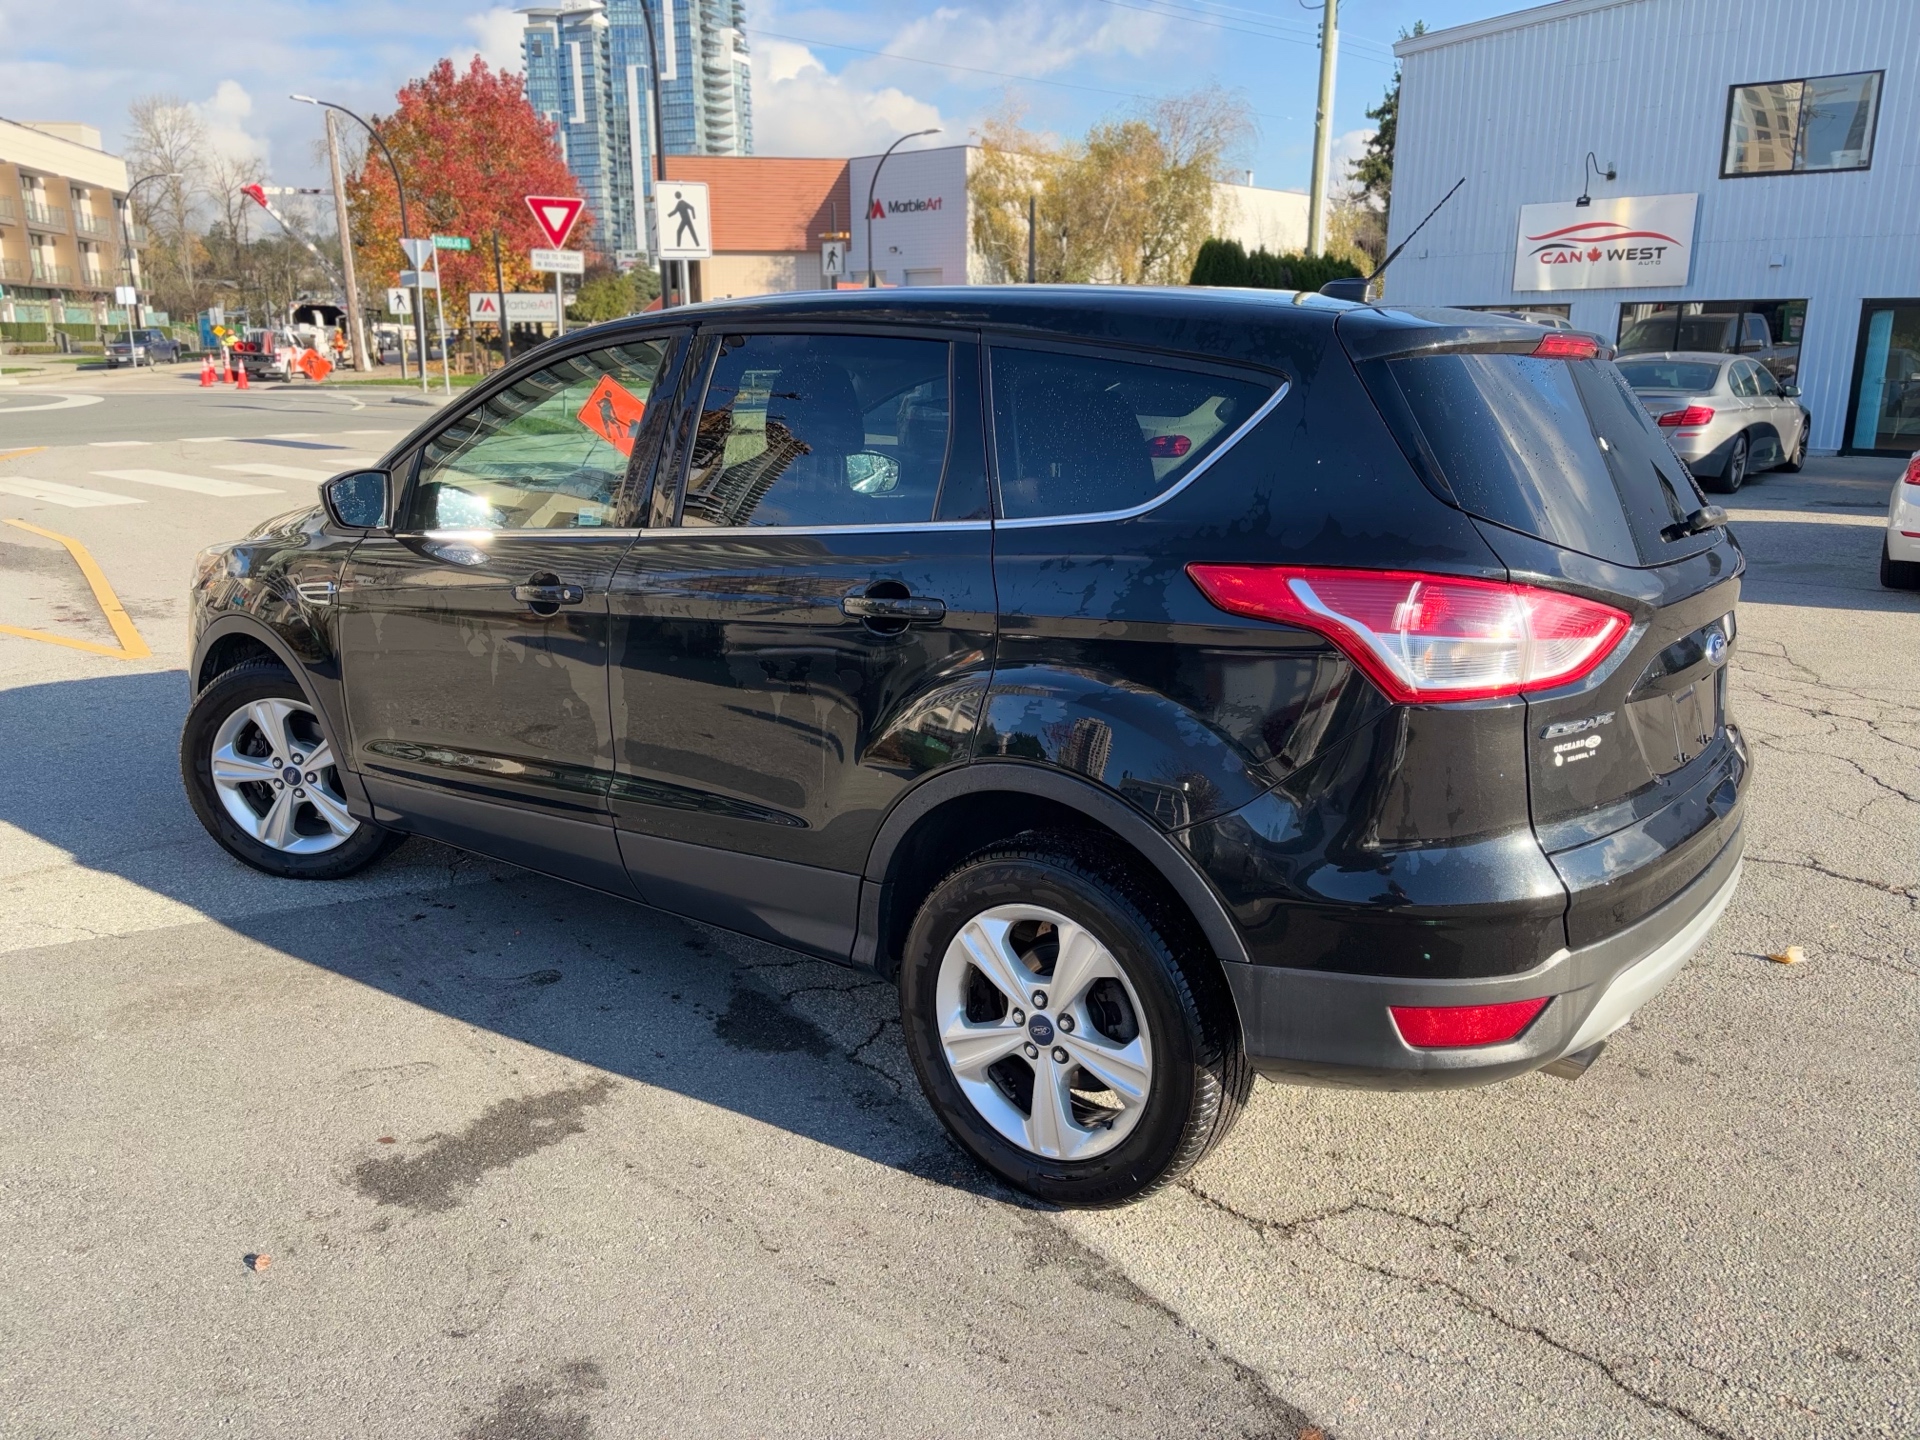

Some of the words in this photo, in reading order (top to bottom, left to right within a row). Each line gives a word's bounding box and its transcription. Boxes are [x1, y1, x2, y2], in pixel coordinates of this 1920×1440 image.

[888, 197, 943, 213] MarbleArt
[437, 237, 461, 248] DOUGLAS
[560, 254, 580, 262] TRAFFIC
[1540, 251, 1582, 264] CAN
[1607, 246, 1668, 261] WEST
[544, 261, 580, 269] ROUNDABOUT
[1540, 711, 1616, 739] ESCAPE
[1553, 739, 1586, 753] ORCHARD
